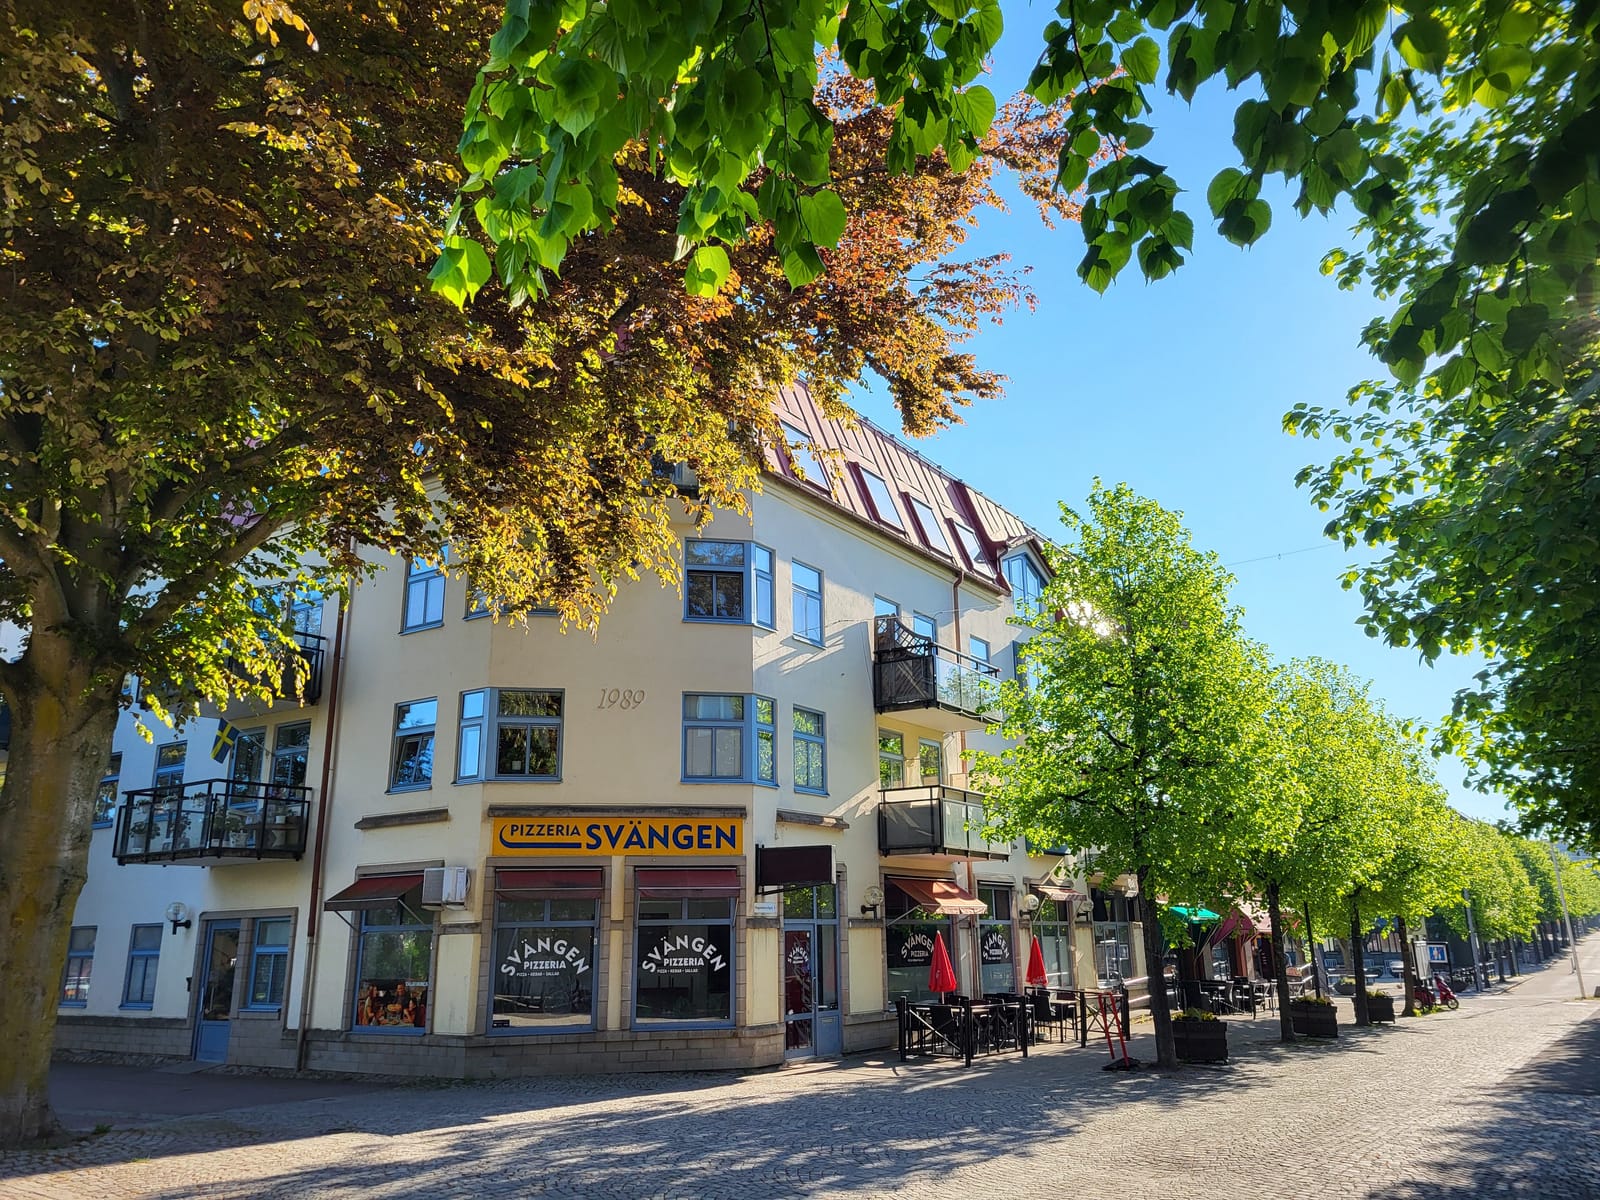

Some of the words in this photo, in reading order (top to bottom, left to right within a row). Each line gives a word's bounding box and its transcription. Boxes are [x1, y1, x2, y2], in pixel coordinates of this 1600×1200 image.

[597, 688, 645, 710] 1989
[510, 824, 581, 837] PIZZERIA
[586, 820, 736, 849] SVÄNGEN
[501, 937, 589, 976] SVÄNGEN
[641, 935, 726, 973] SVÄNGEN
[983, 932, 1010, 960] SVÄNGEN
[523, 960, 567, 970] PIZZERIA
[663, 958, 705, 967] PIZZERIA
